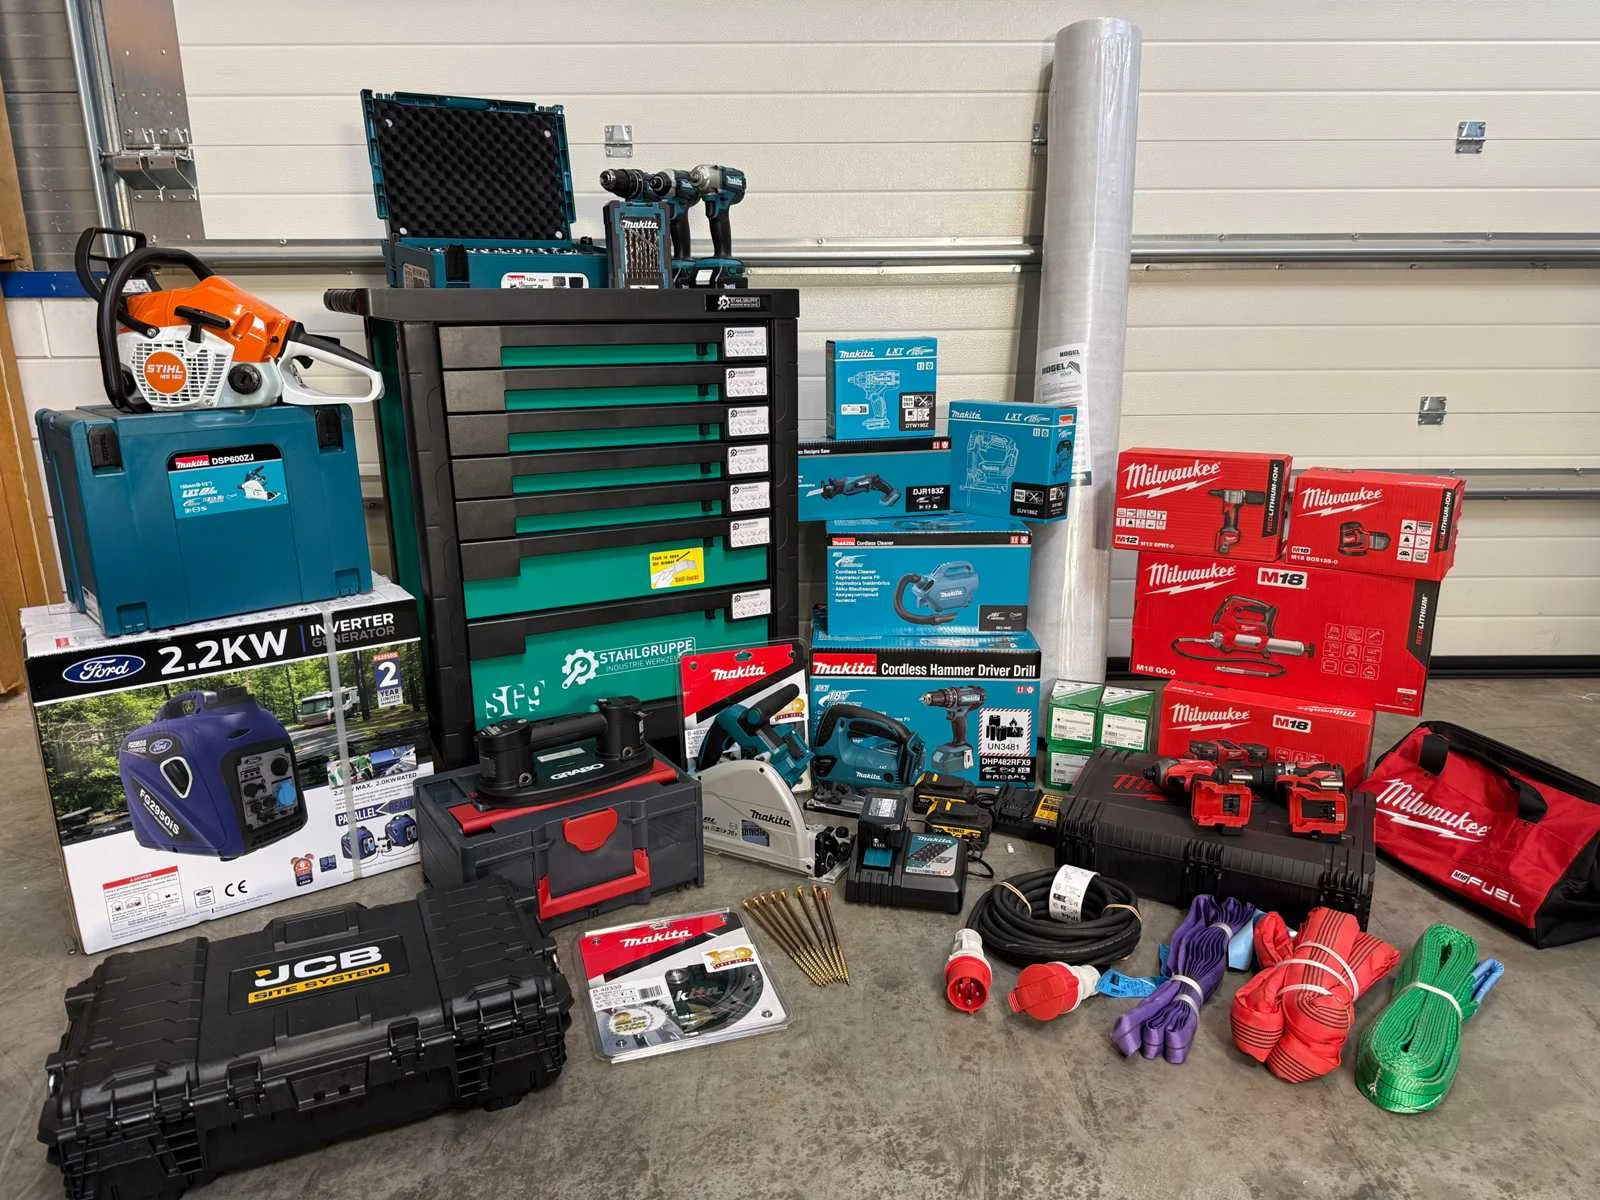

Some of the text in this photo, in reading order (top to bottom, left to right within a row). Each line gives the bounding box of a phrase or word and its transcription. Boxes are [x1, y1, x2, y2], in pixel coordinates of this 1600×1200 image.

[885, 347, 904, 356] LXT
[146, 364, 184, 374] STIHL
[1005, 412, 1022, 421] LXT
[211, 453, 255, 466] DSP600ZJ
[1121, 459, 1221, 491] Milwaukee
[912, 487, 945, 496] DJR183Z
[1299, 487, 1383, 510] Milwaukee
[1116, 535, 1138, 544] M12
[1145, 562, 1237, 588] Milwaukee
[1260, 571, 1305, 586] M18
[310, 612, 395, 638] INVERTER
[157, 628, 288, 676] 2.2KW
[599, 638, 694, 665] STAHLGRUPPE
[79, 658, 130, 681] Ford
[605, 656, 645, 673] INDUSTRIE
[881, 662, 927, 676] Cordless
[930, 663, 975, 677] Hammer
[978, 664, 1011, 678] Driver
[1013, 664, 1036, 678] Drill
[1136, 664, 1154, 672] M18
[378, 661, 399, 688] 2
[380, 688, 399, 697] YEAR
[1169, 702, 1250, 723] Milwaukee
[1274, 716, 1310, 731] M18
[987, 743, 1020, 751] UN3481
[981, 758, 1032, 766] DHP482RFX9
[396, 771, 418, 781] RATED
[550, 762, 605, 781] GRABO
[338, 807, 378, 826] PAALLEL
[1376, 778, 1491, 838] Milwaukee
[1467, 875, 1521, 908] FUEL
[254, 945, 383, 987] JCB
[254, 965, 386, 1000] SITE SYSTEM
